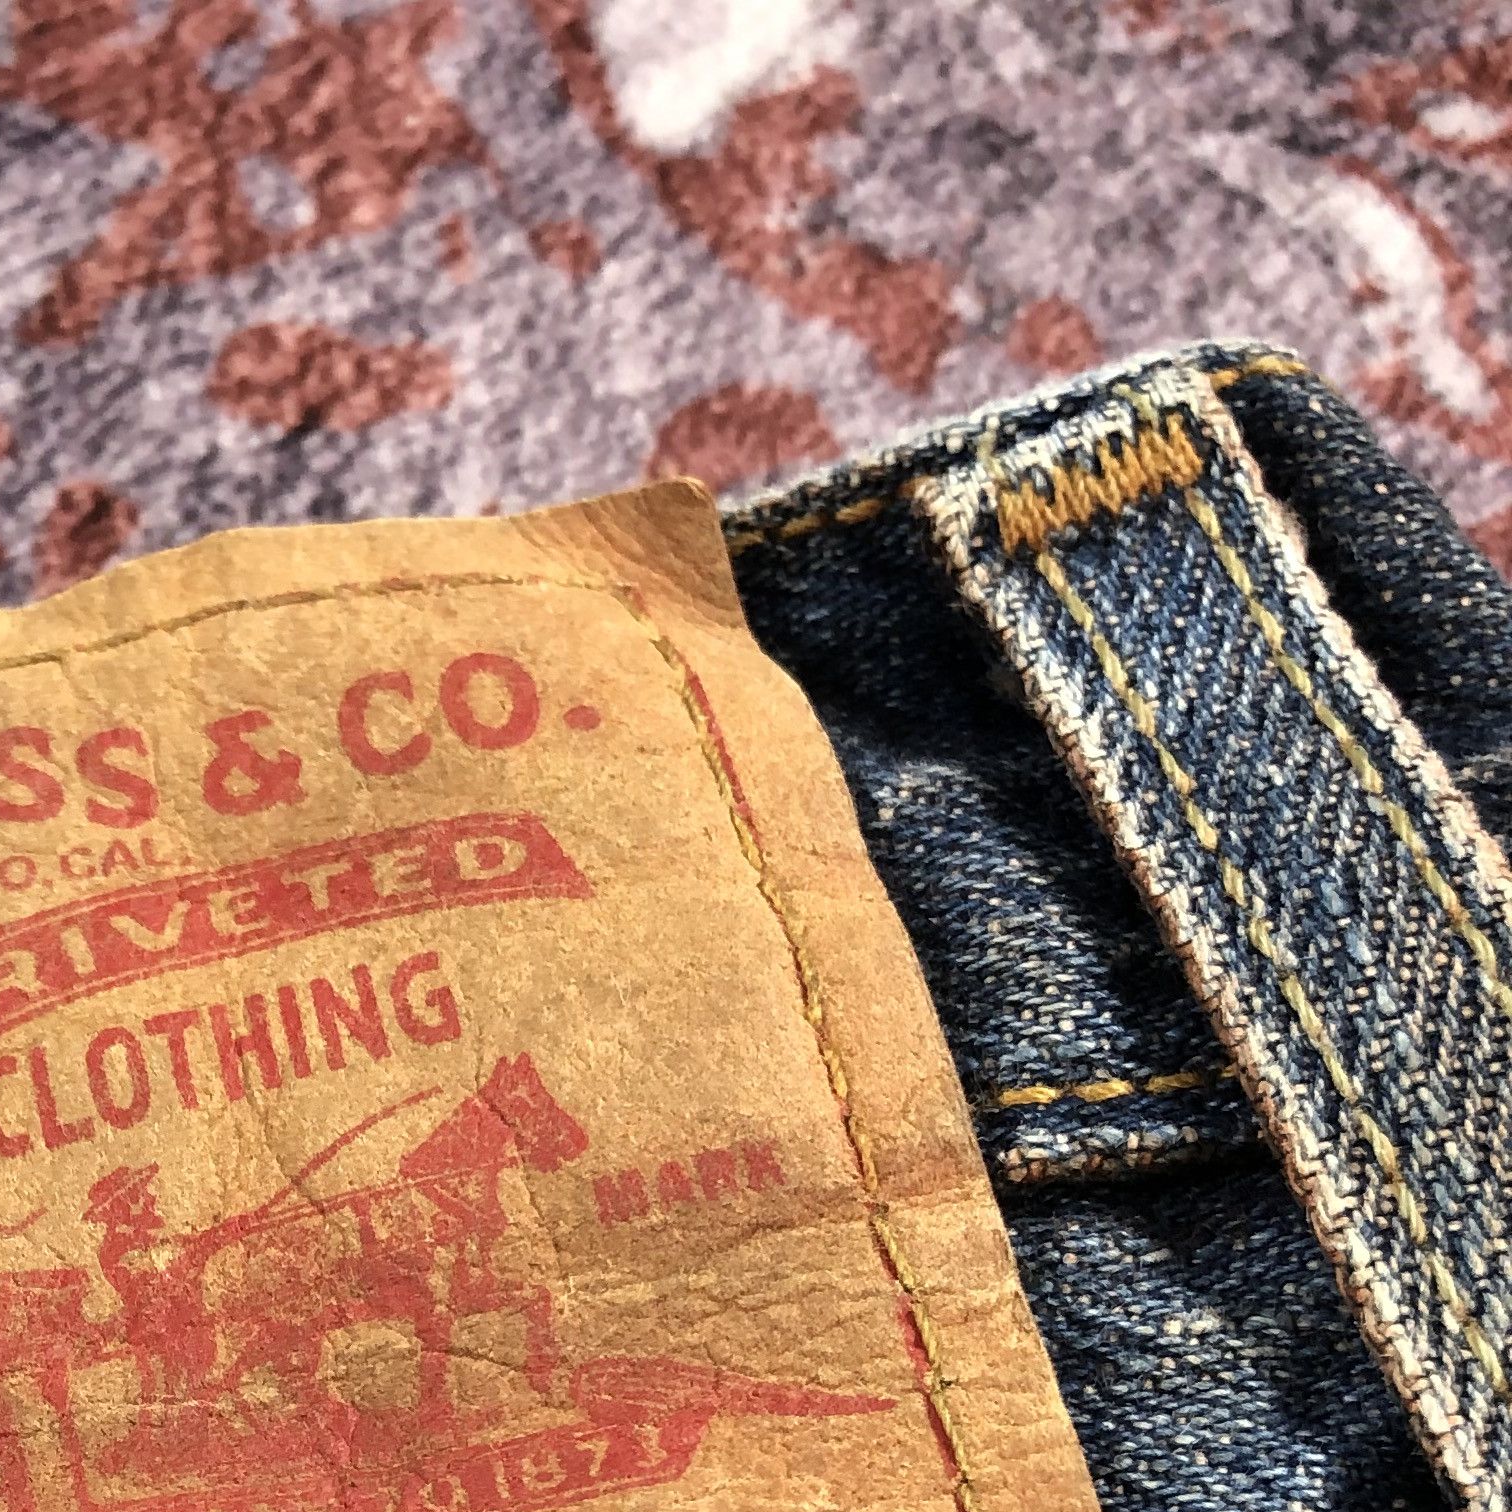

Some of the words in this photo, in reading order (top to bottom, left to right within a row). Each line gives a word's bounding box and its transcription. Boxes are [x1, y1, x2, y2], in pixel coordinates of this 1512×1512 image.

[201, 709, 307, 817] &
[336, 651, 602, 777] CO.
[592, 1136, 787, 1229] MARK
